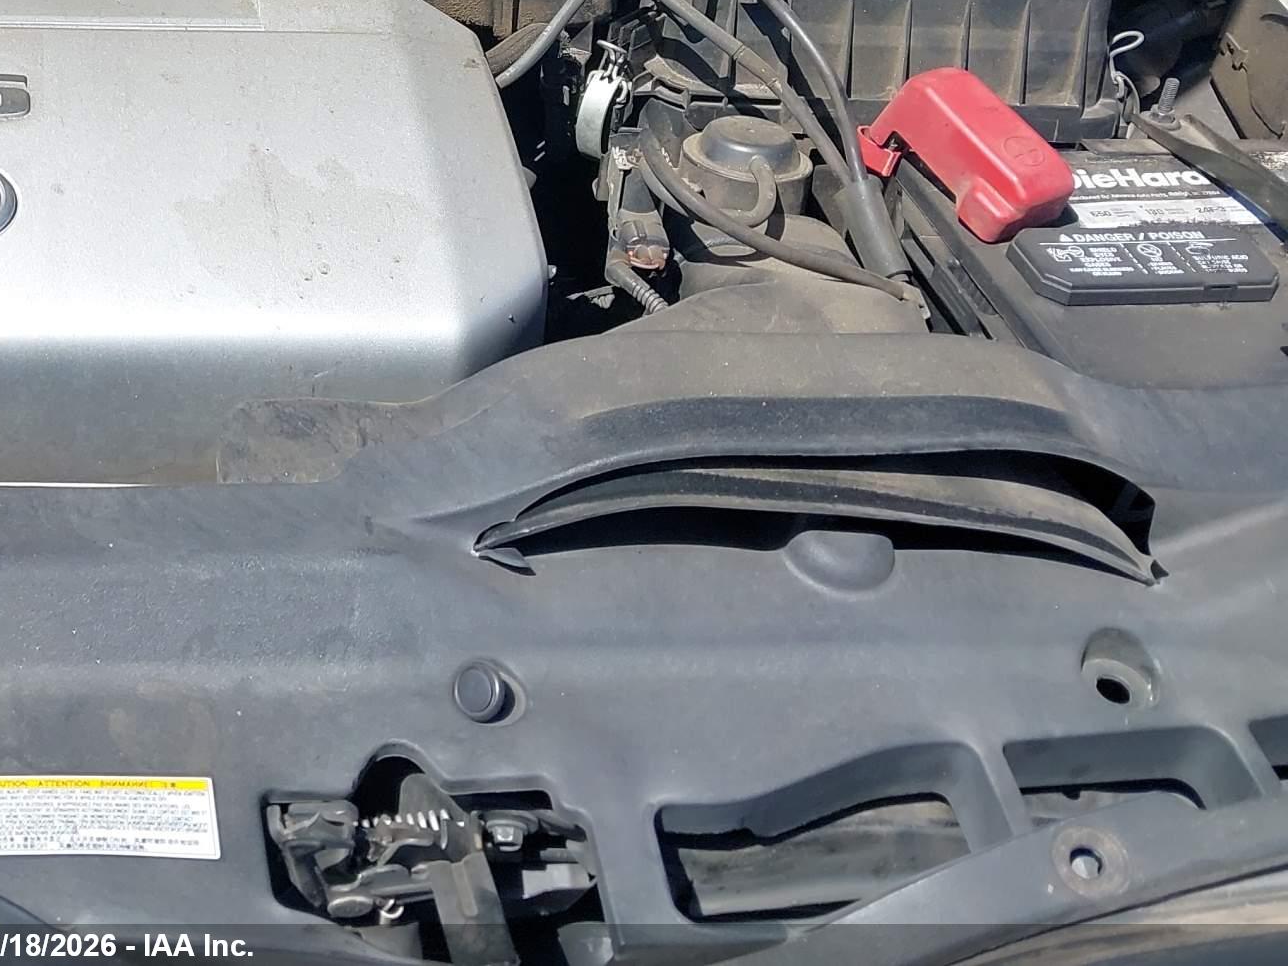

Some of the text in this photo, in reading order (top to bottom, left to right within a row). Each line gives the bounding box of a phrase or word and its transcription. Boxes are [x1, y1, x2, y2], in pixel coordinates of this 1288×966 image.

[1073, 233, 1135, 243] DANGER
[1147, 230, 1205, 240] POISON
[37, 779, 91, 788] ATTENTION
